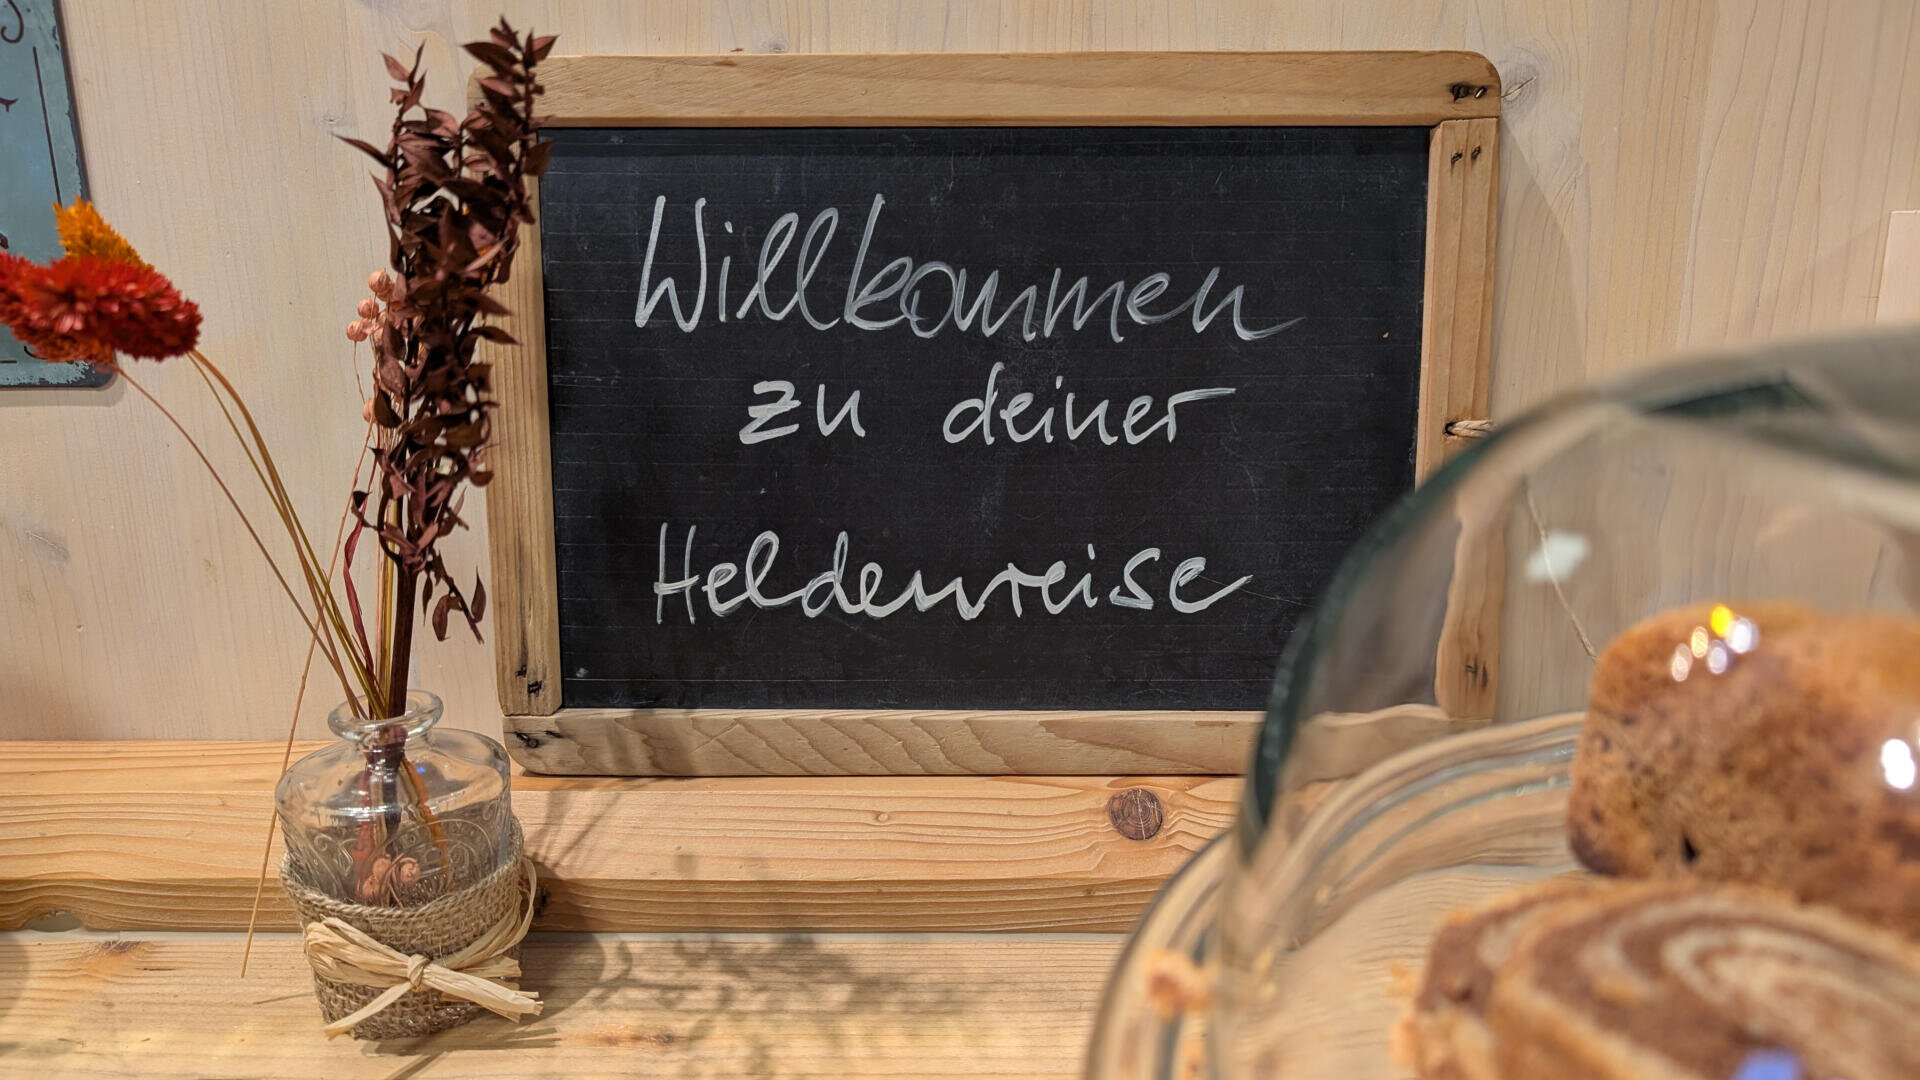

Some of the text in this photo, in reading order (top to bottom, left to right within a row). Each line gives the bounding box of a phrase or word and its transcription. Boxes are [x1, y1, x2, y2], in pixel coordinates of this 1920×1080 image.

[634, 193, 1304, 343] Willkommen
[738, 361, 1237, 446] zu deiner
[653, 522, 1255, 625] Heldenreise
